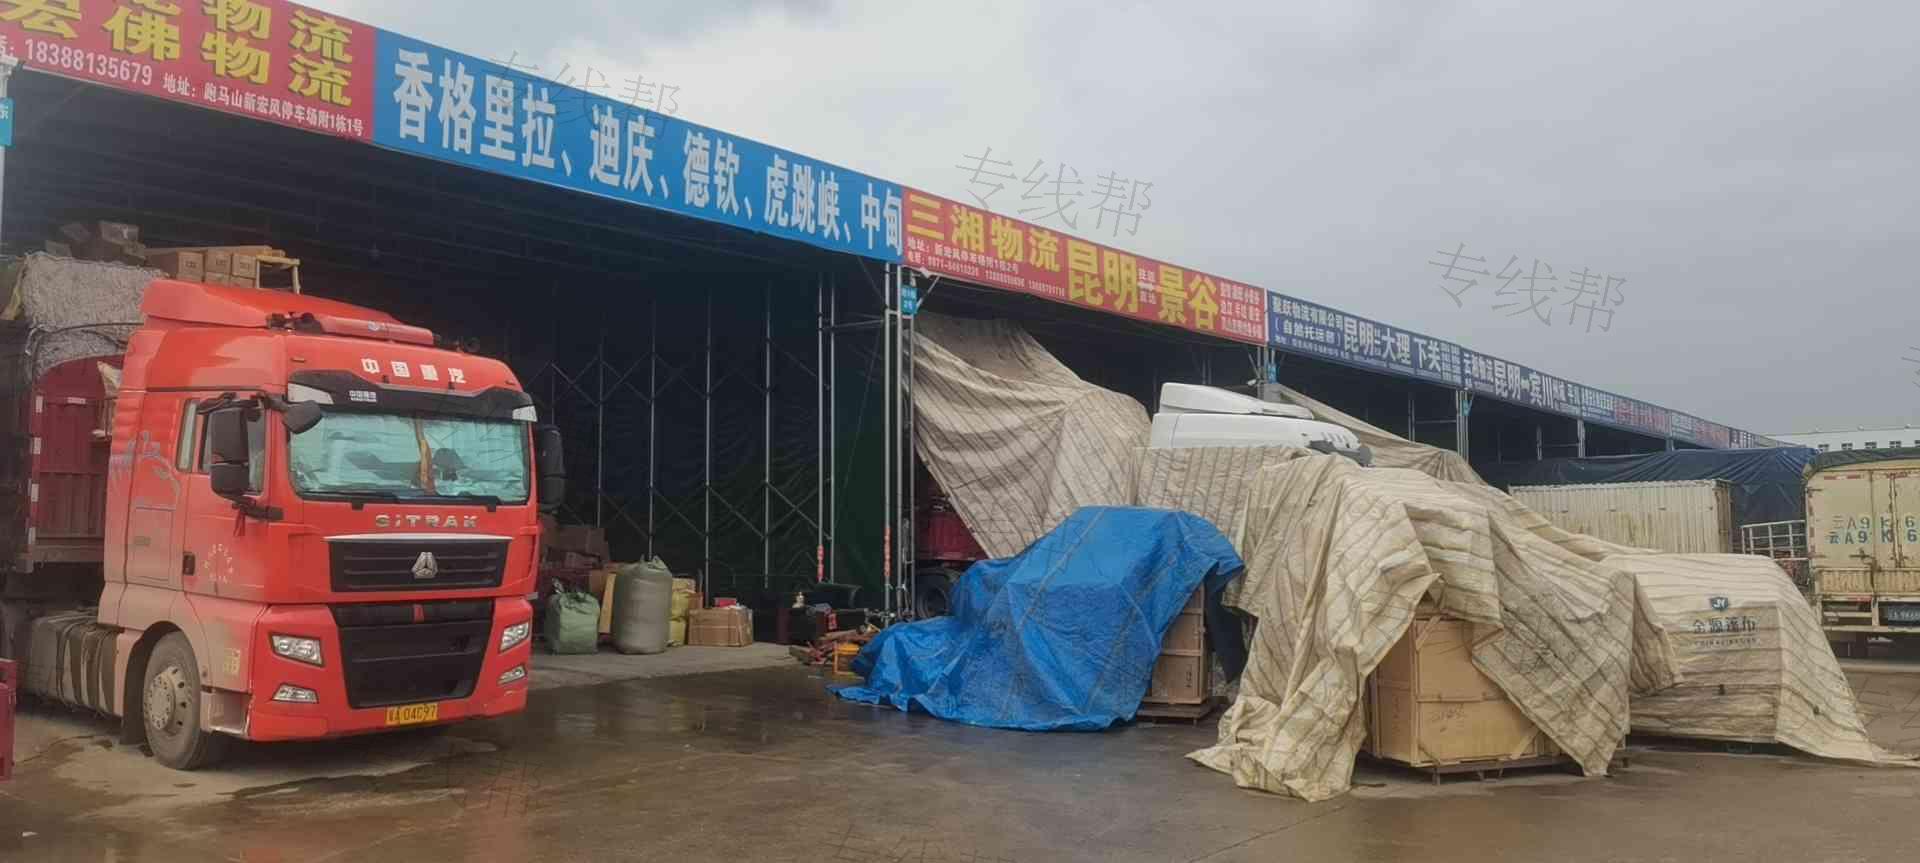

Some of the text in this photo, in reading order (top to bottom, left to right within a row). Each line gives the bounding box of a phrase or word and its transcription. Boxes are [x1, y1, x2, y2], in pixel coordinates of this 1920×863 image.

[907, 193, 1060, 272] 三湘物流
[1067, 240, 1138, 313] 昆明
[1157, 265, 1219, 331] 景谷
[1343, 316, 1377, 357] 昆明
[1381, 328, 1412, 367] 大理
[1413, 337, 1441, 373] 下关
[375, 514, 479, 528] SITRAK
